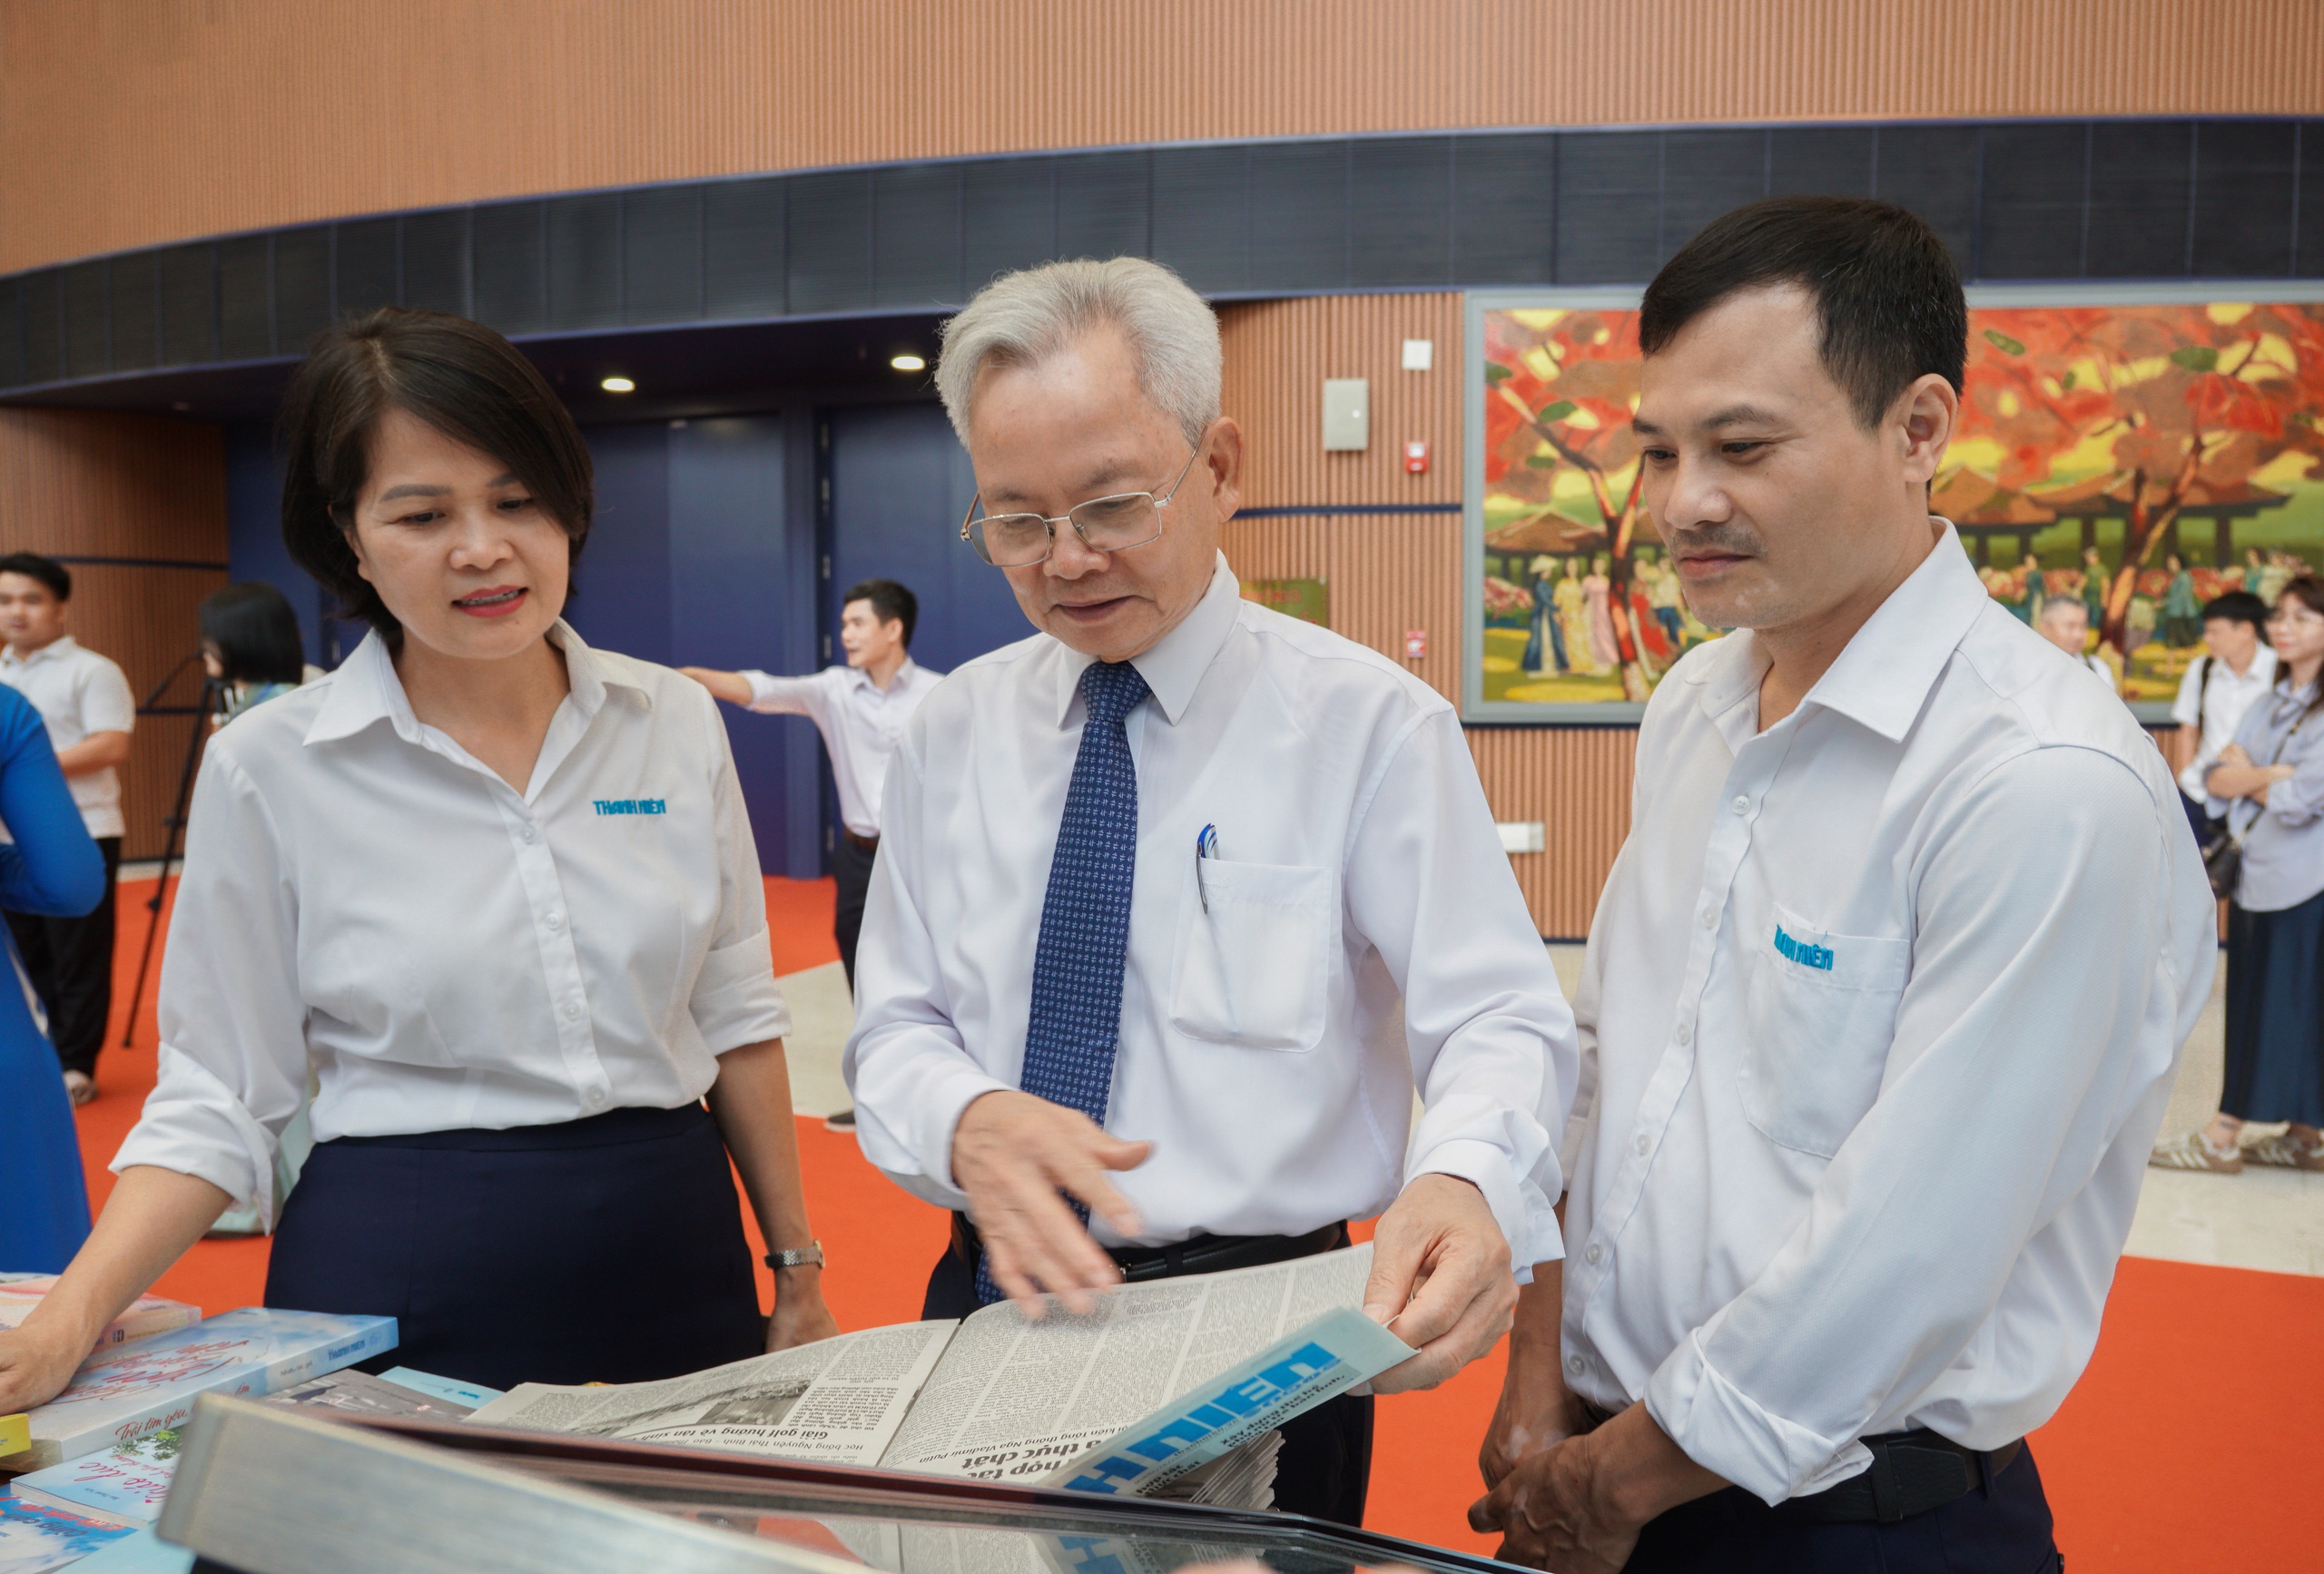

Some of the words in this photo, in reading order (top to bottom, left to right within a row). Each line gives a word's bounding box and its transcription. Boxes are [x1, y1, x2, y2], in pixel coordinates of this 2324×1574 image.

[144, 1416, 162, 1431] tim
[767, 1429, 799, 1438] golf
[799, 1431, 828, 1440] Giải
[1000, 1441, 1022, 1449] Nga
[950, 1445, 996, 1457] Vladimir
[1022, 1444, 1078, 1458] thực
[919, 1452, 948, 1463] Putin
[961, 1452, 1019, 1470] chất
